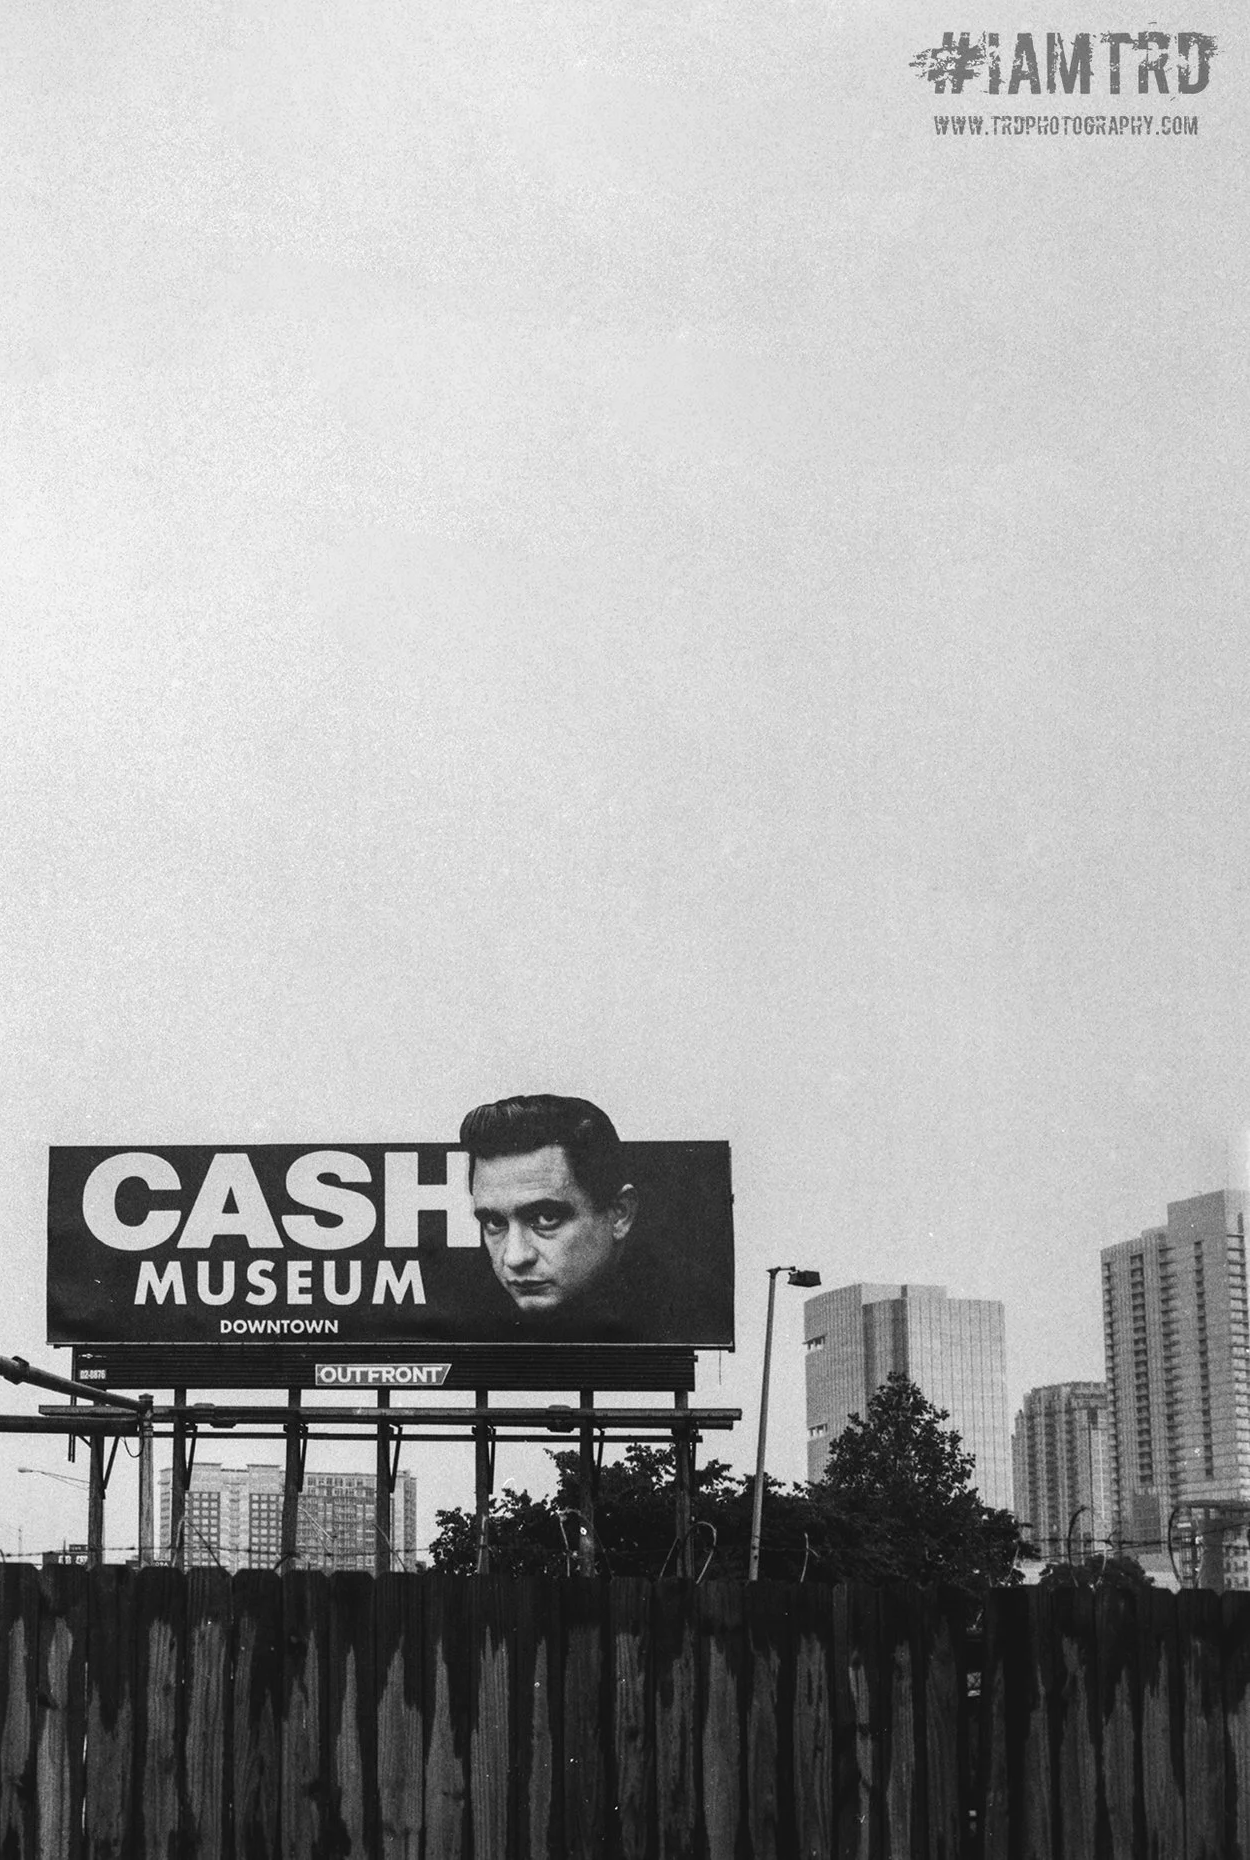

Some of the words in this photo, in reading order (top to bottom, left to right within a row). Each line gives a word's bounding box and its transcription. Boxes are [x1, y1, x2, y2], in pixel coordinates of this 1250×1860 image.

[82, 1150, 481, 1251] CASH
[134, 1259, 426, 1305] MUSEUM
[220, 1319, 339, 1334] DOWNTOWN
[320, 1367, 443, 1383] OUTFRONT
